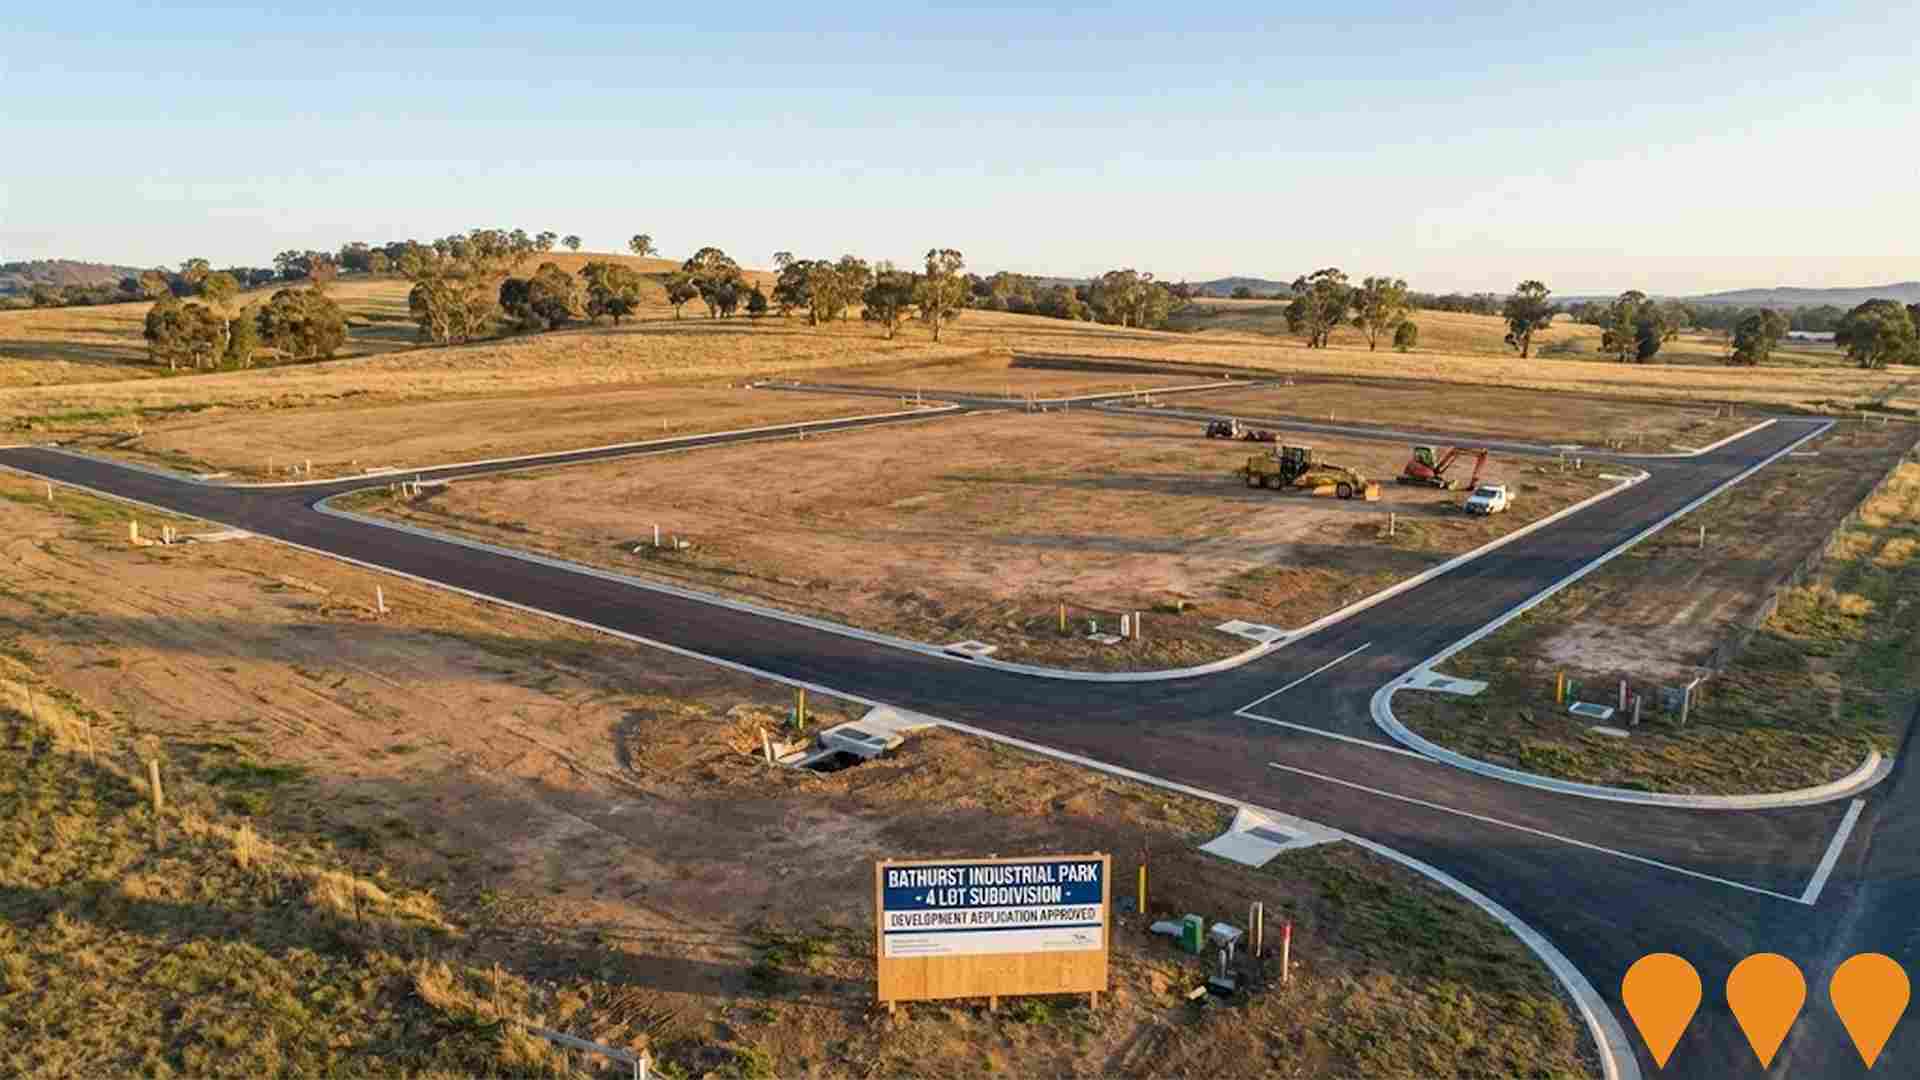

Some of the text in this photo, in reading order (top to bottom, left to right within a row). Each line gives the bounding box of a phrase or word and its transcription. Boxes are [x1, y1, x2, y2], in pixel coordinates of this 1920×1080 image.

[888, 863, 1098, 888] BATHURST INDUSTRIAL PARK
[970, 885, 1061, 905] SUBDIVISION
[891, 911, 968, 927] DEVELOPMENT
[1039, 907, 1096, 922] APPROVED
